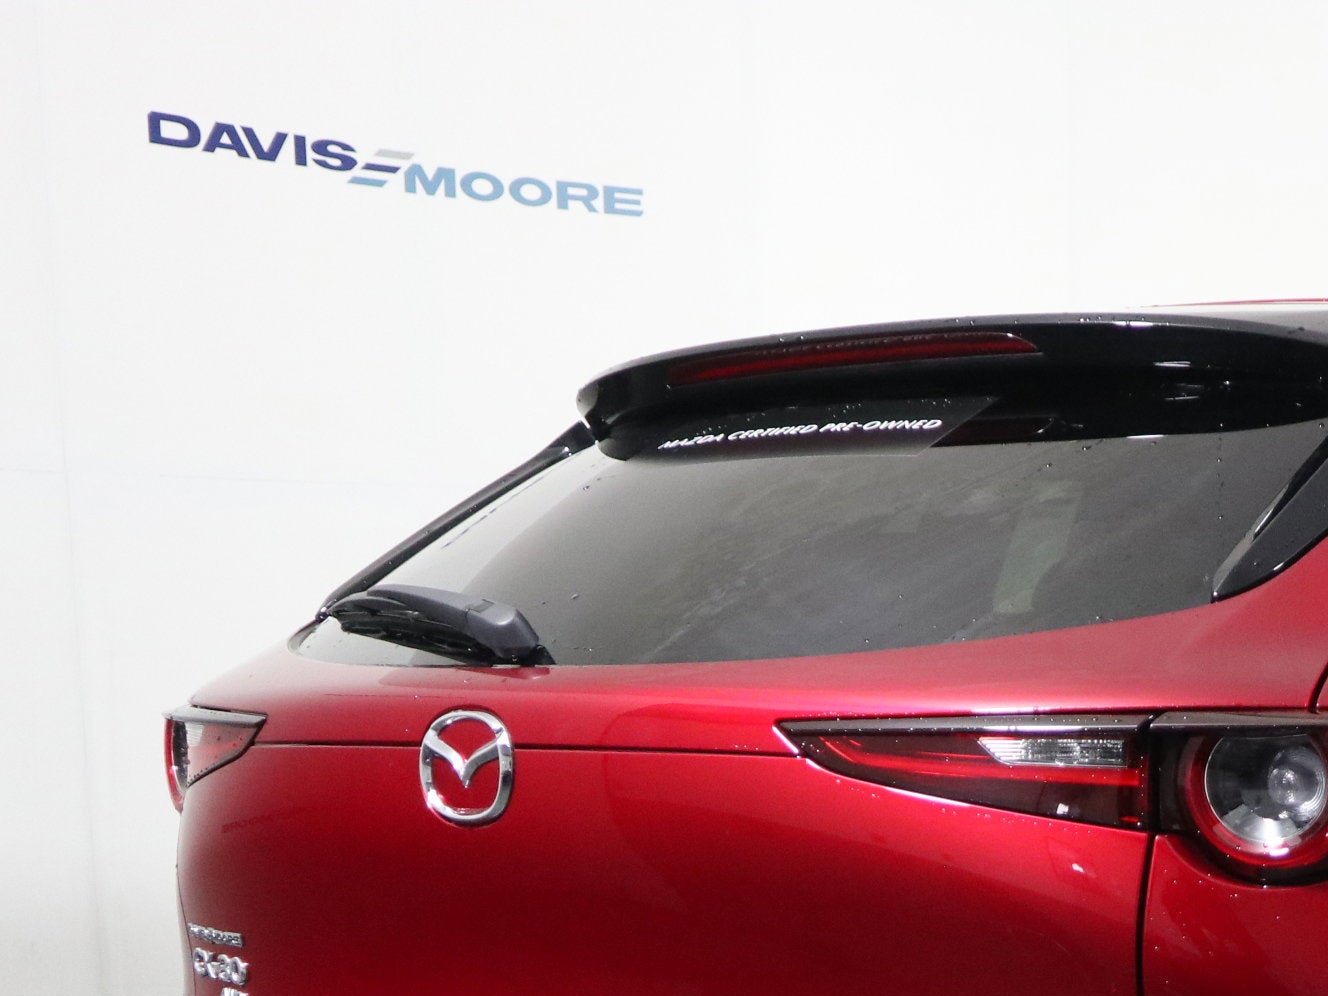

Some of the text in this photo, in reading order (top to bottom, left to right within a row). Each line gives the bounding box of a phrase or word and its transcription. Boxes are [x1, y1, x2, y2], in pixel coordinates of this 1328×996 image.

[146, 110, 644, 217] DAVIS MOORE
[657, 419, 943, 449] MAZDA CERTIFIED PRE-OWNED
